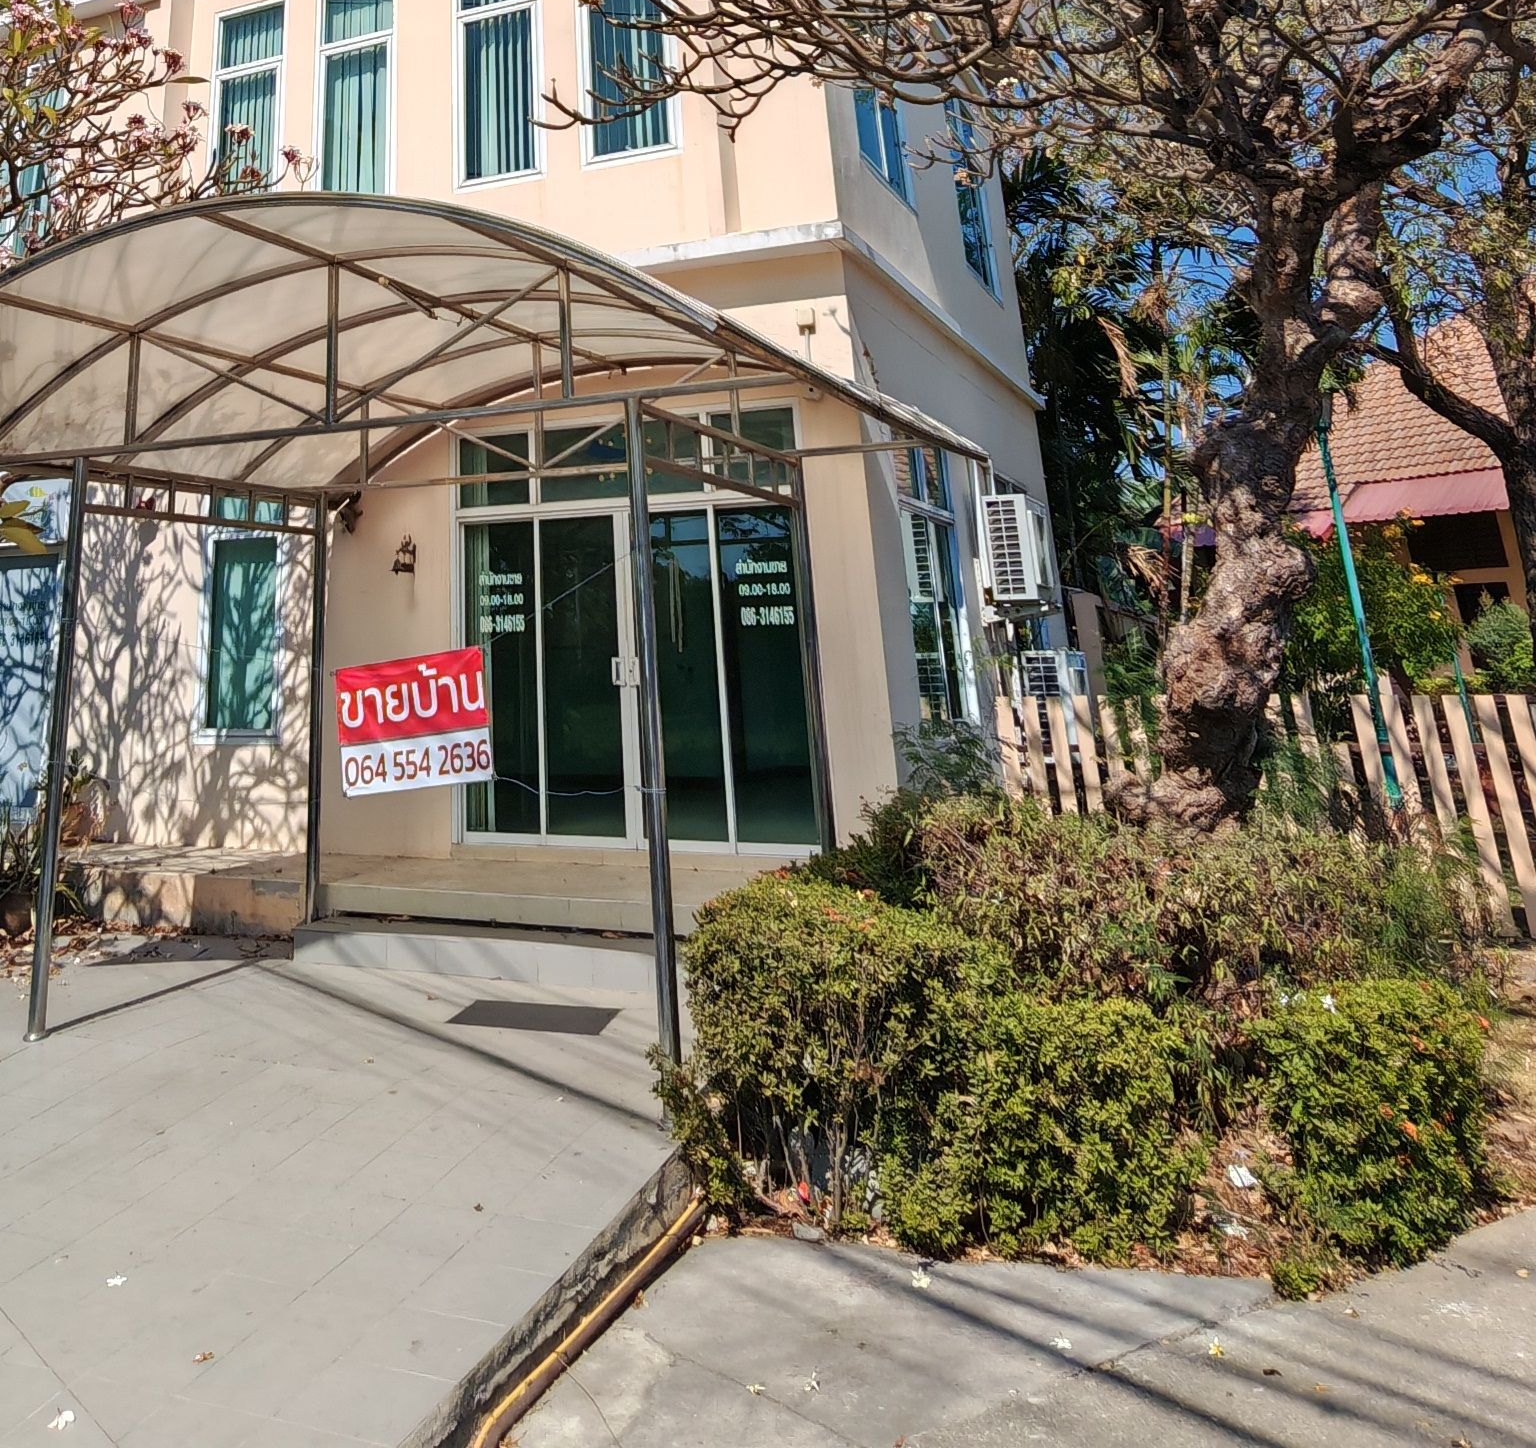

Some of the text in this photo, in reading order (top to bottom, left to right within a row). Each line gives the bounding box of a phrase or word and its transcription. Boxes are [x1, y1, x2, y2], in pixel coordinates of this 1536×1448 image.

[738, 582, 790, 596] 09.00-18.00
[341, 663, 485, 728] ขายบ้าน
[345, 739, 490, 787] 064 554 2636
